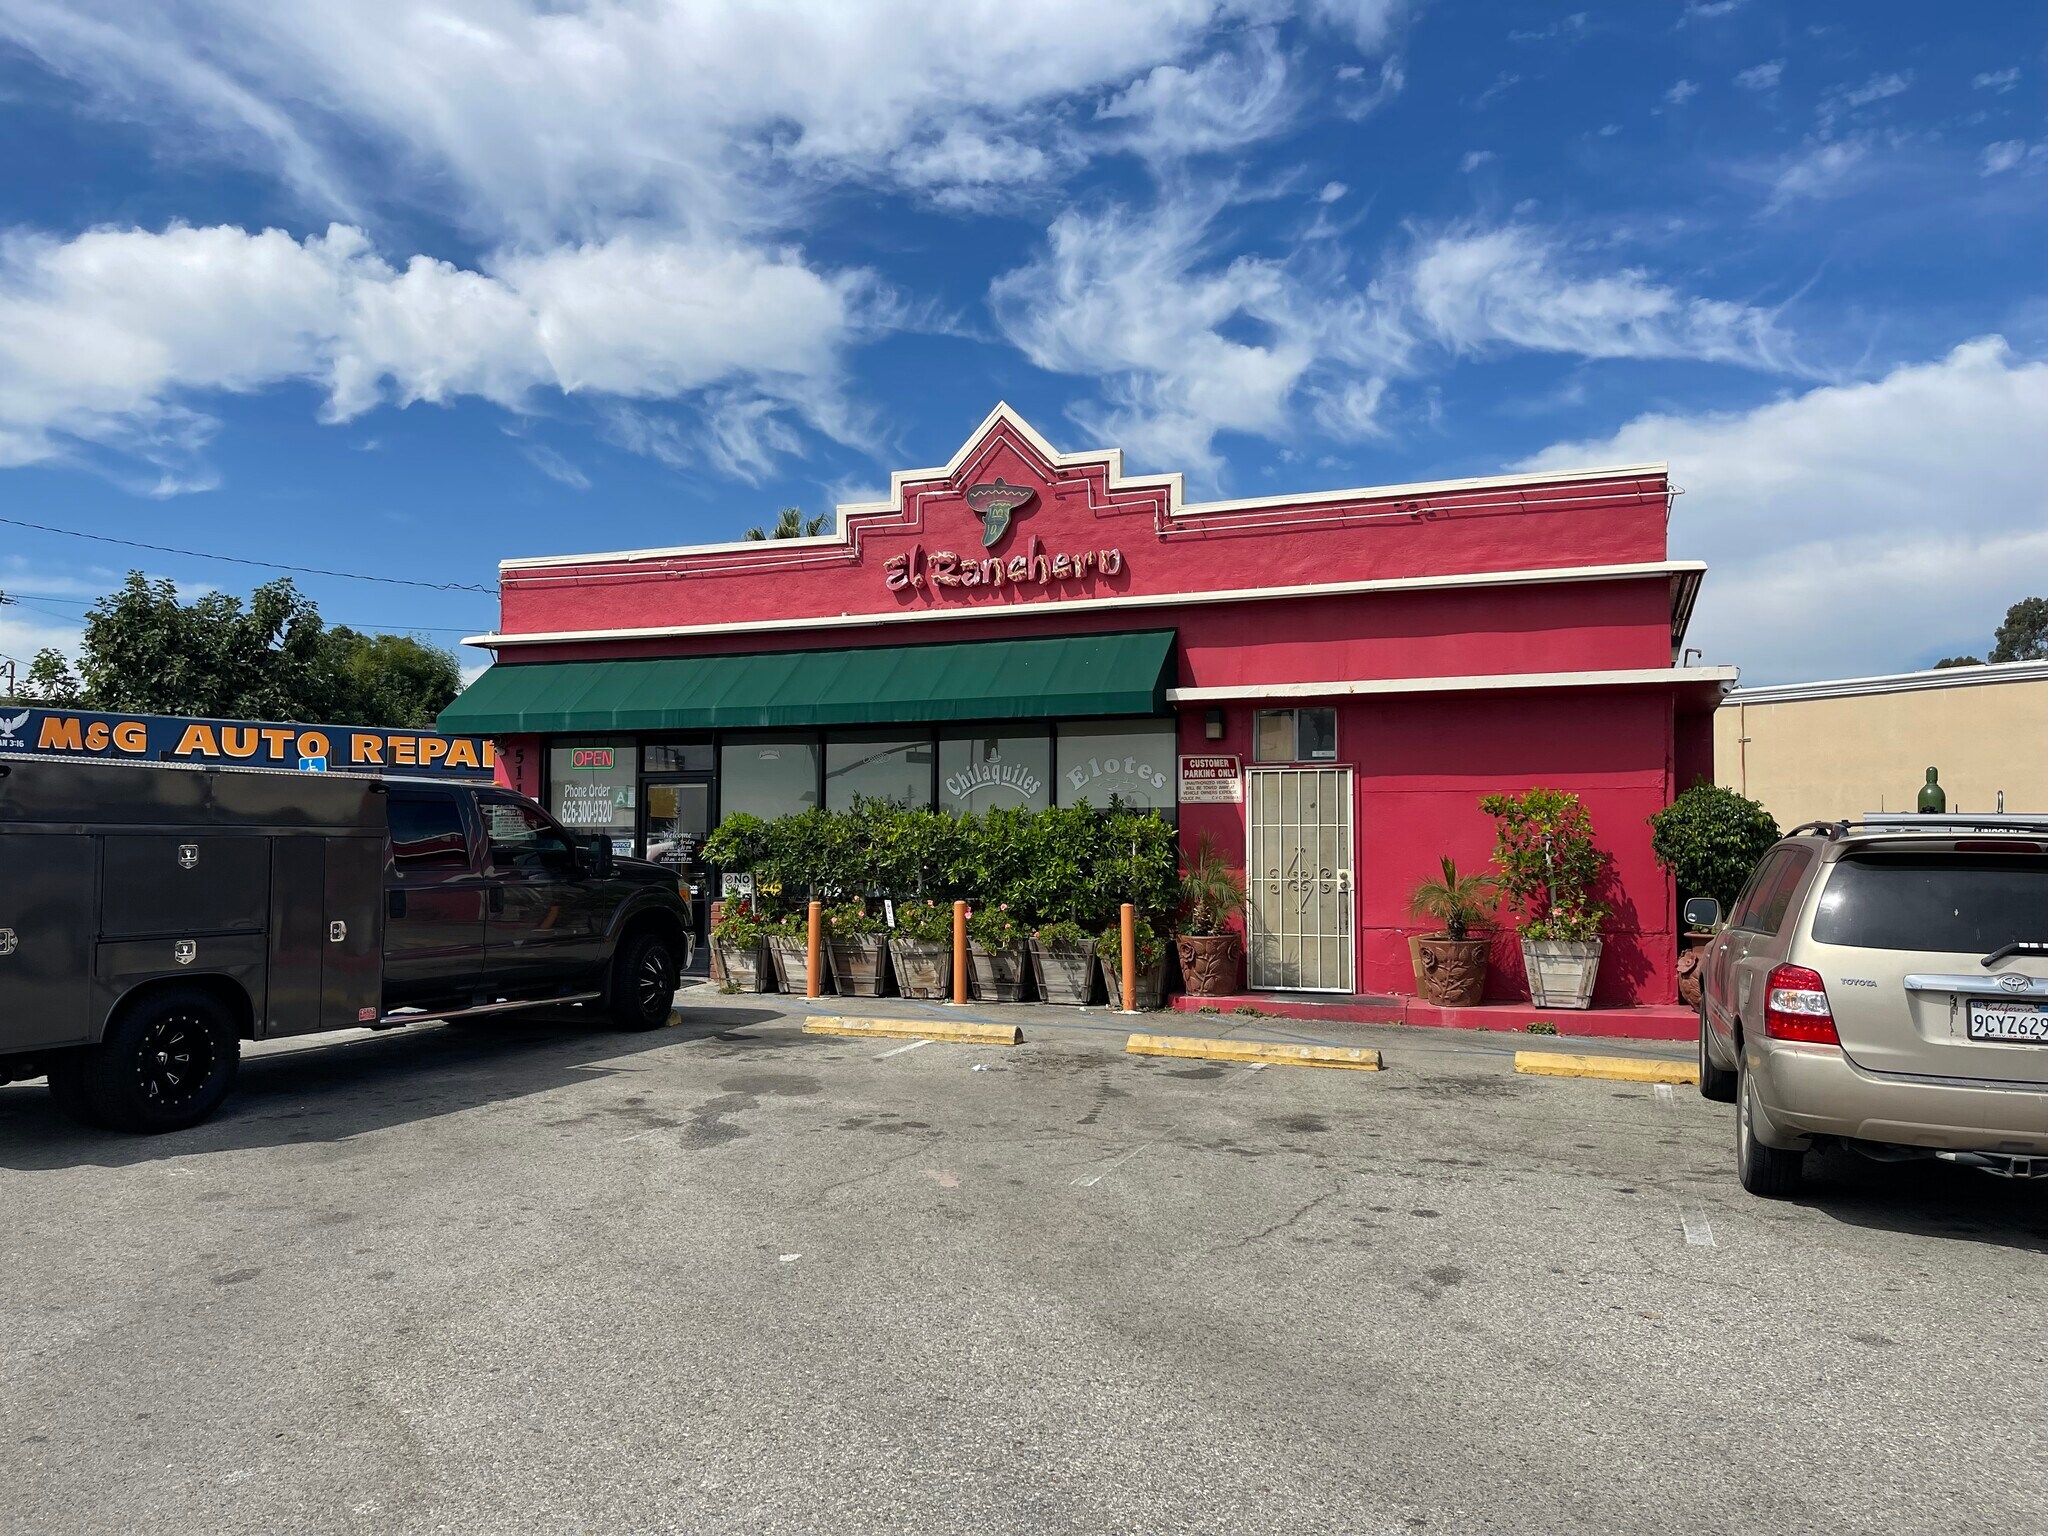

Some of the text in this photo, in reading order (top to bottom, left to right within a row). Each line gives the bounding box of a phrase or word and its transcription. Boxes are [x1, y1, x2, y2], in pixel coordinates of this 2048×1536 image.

[883, 534, 1122, 591] El Ranchero
[9, 740, 25, 748] 3:16
[37, 716, 147, 753] M&G
[174, 724, 330, 759] AUTO
[573, 750, 613, 767] OPEN
[1190, 759, 1229, 768] CUSTOMER
[945, 762, 1042, 797] Chilaquiles
[1065, 755, 1167, 791] Elotes
[1184, 769, 1236, 778] PARKING ONLY
[564, 783, 610, 797] Phone Order
[616, 791, 626, 803] A
[562, 800, 613, 823] 626-300-9320
[662, 830, 692, 839] Welcome
[734, 875, 750, 884] NO
[1840, 978, 1877, 988] TOYOTA
[1984, 1002, 2038, 1014] California
[1974, 1014, 2048, 1036] 9CYZ629
